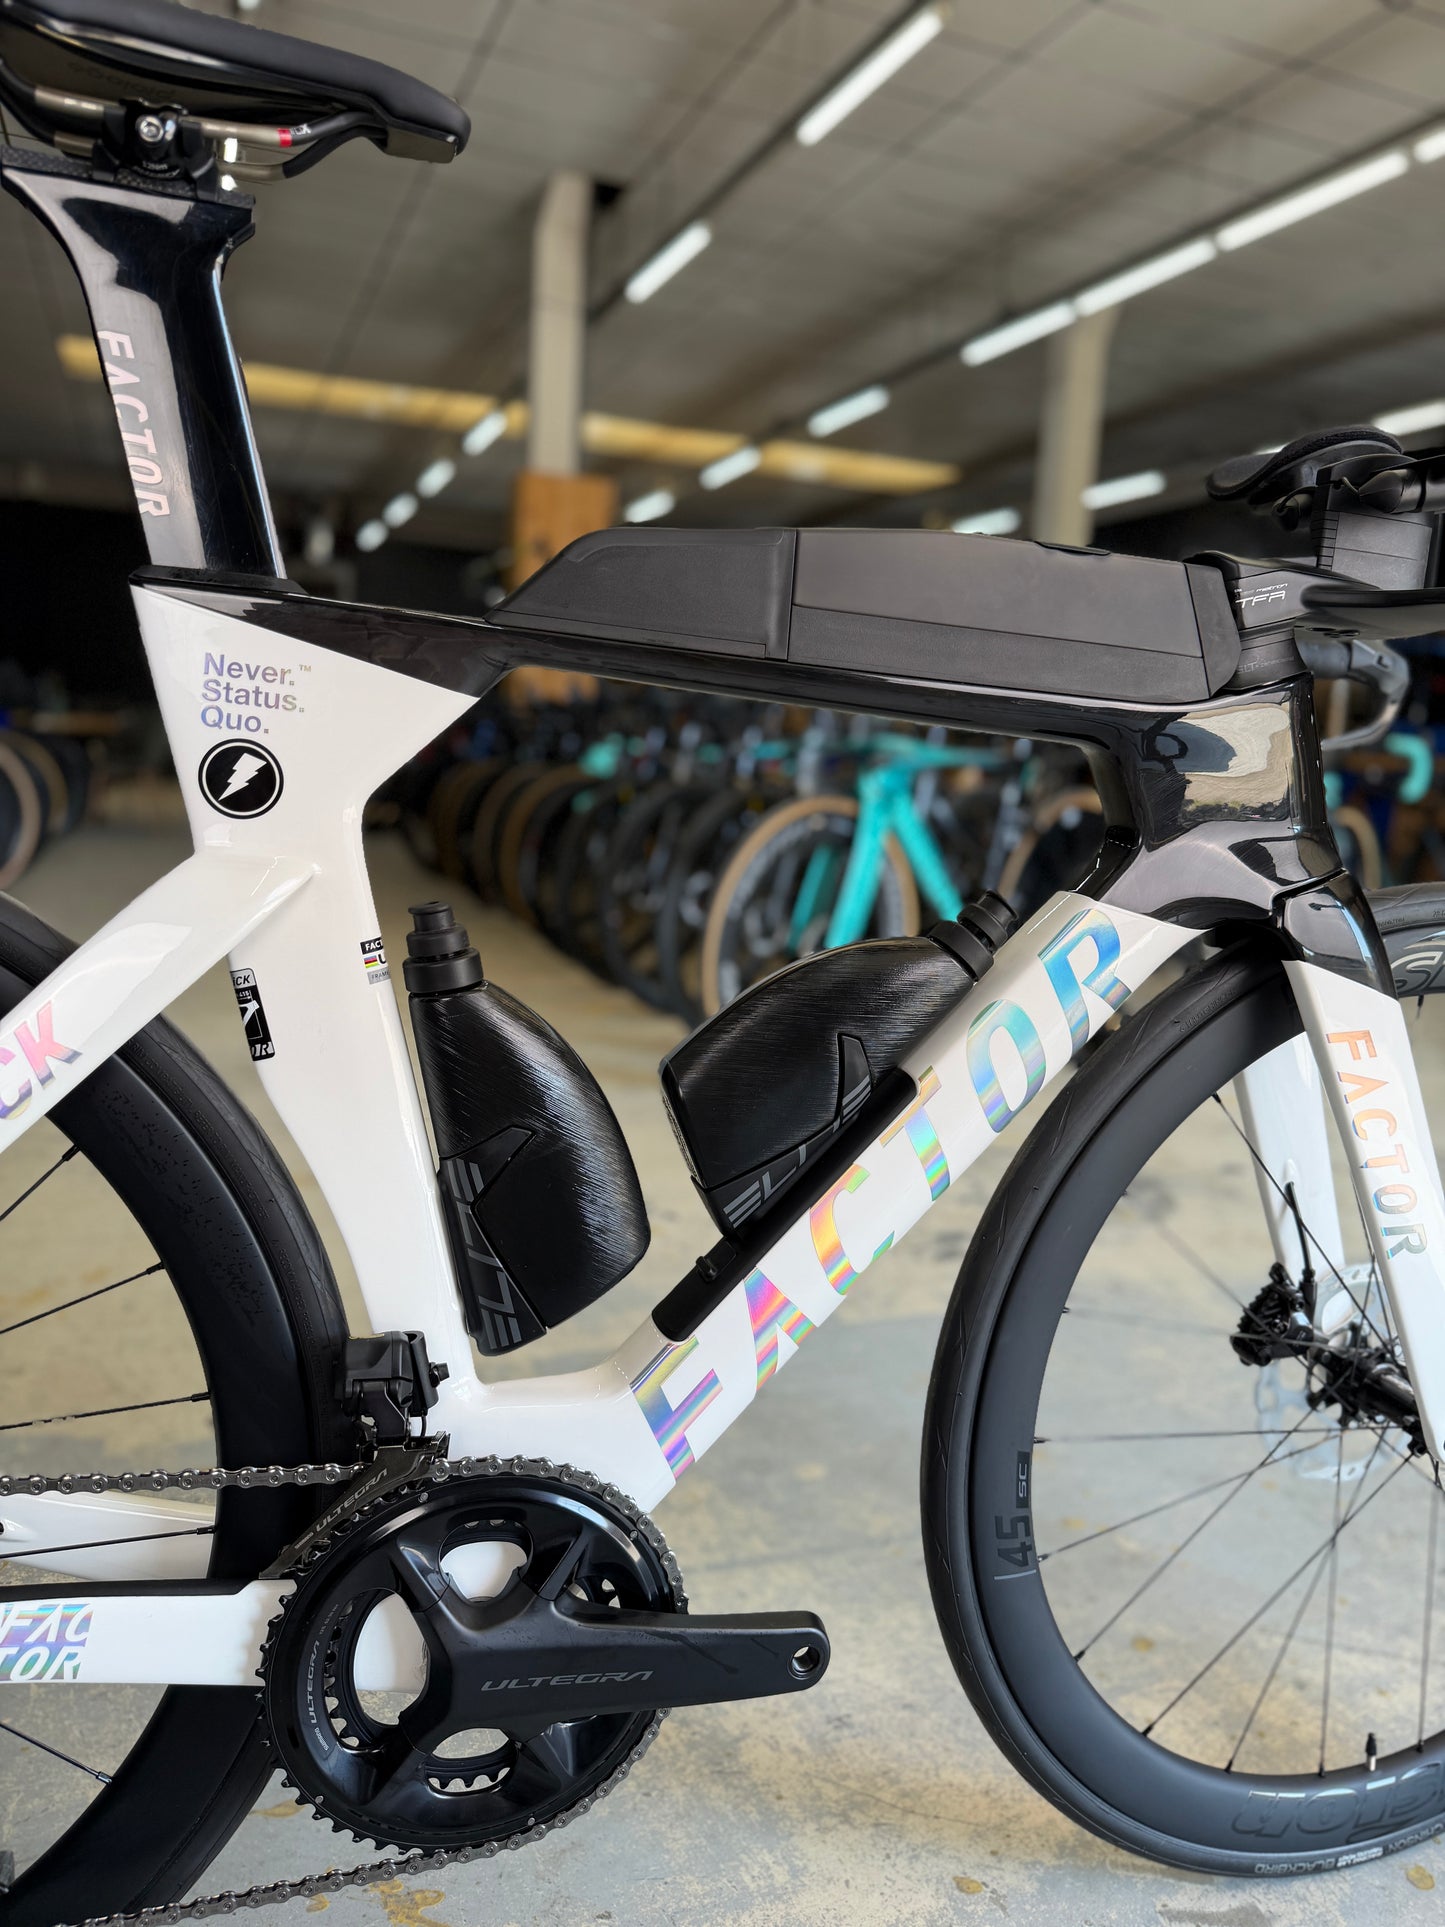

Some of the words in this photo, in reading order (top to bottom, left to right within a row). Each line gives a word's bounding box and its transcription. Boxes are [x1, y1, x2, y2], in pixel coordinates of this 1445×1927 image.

[97, 330, 170, 517] FACTOR
[1235, 590, 1286, 608] TFA
[202, 679, 304, 713] Status.
[203, 652, 295, 686] Never.
[201, 705, 269, 734] Quo.
[1326, 1030, 1428, 1260] FACTOR
[630, 908, 1133, 1482] FACTOR
[316, 1468, 388, 1532] ULTEGRA
[994, 1515, 1033, 1568] 45
[1018, 1463, 1028, 1498] SC
[306, 1640, 320, 1724] ULTEGRA
[480, 1670, 655, 1692] ULTEGRA
